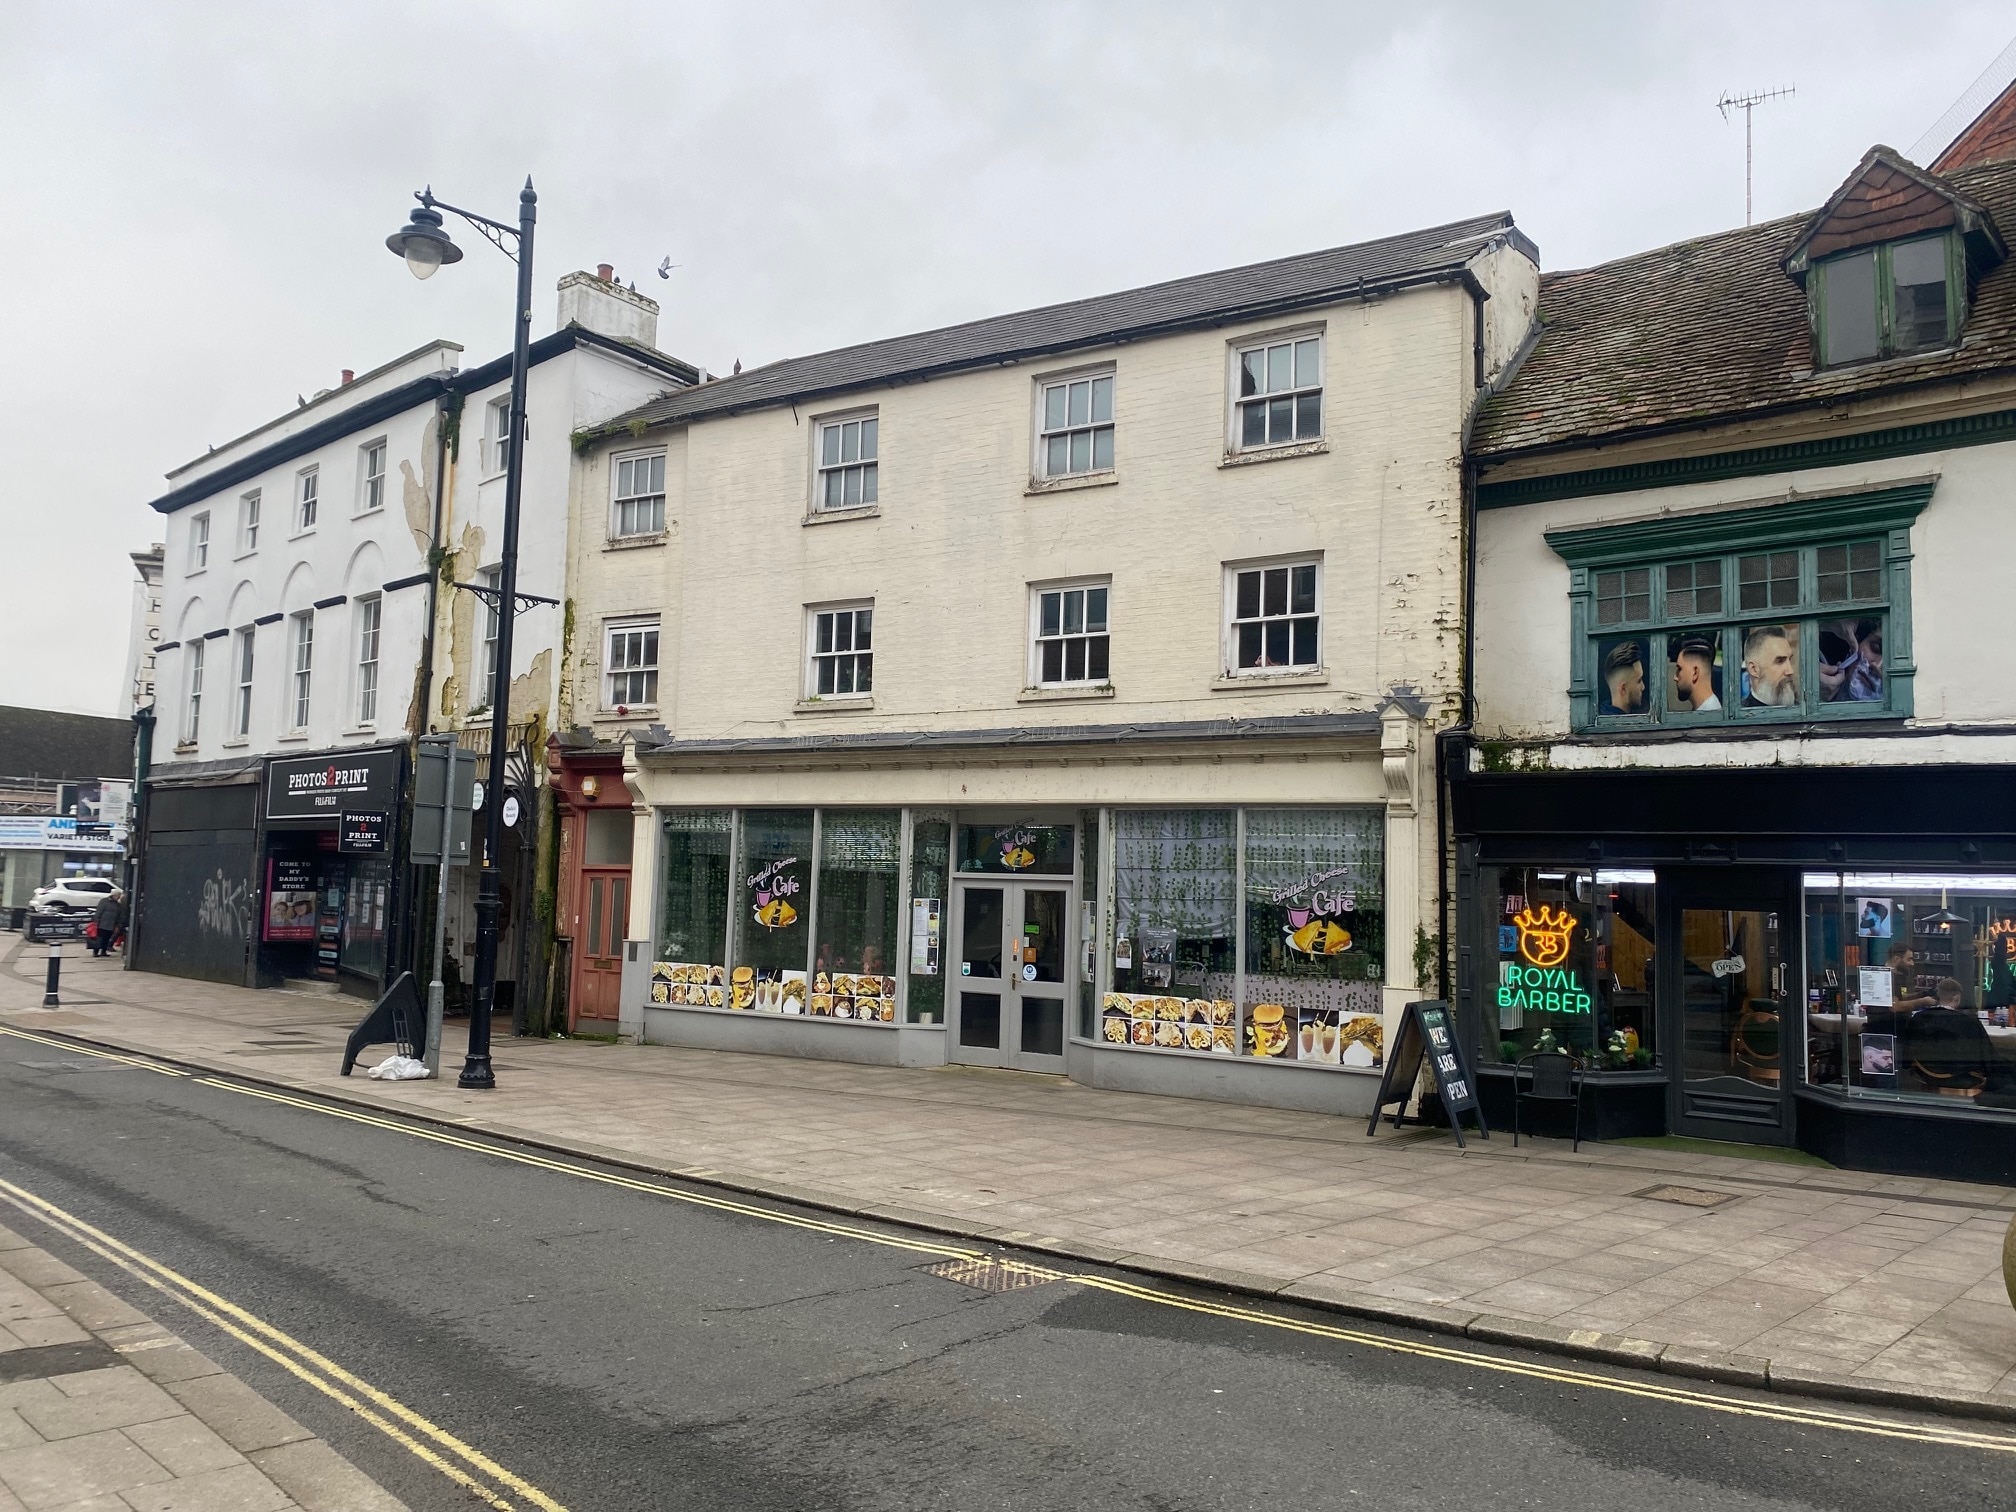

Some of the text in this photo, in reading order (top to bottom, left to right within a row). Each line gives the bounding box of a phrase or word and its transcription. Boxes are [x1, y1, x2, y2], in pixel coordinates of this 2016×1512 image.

[47, 833, 83, 841] VARIETY
[360, 823, 367, 831] 2
[1014, 831, 1036, 845] Cafe
[747, 857, 797, 888] Grilled Cheese
[772, 876, 800, 897] Cafe
[1272, 867, 1348, 905] Grilled Cheese
[1312, 890, 1354, 916] Cafe
[1716, 962, 1742, 971] OPEN
[1508, 965, 1583, 991] ROYAL
[1497, 986, 1592, 1015] BARBER
[1437, 1053, 1457, 1072] ARE
